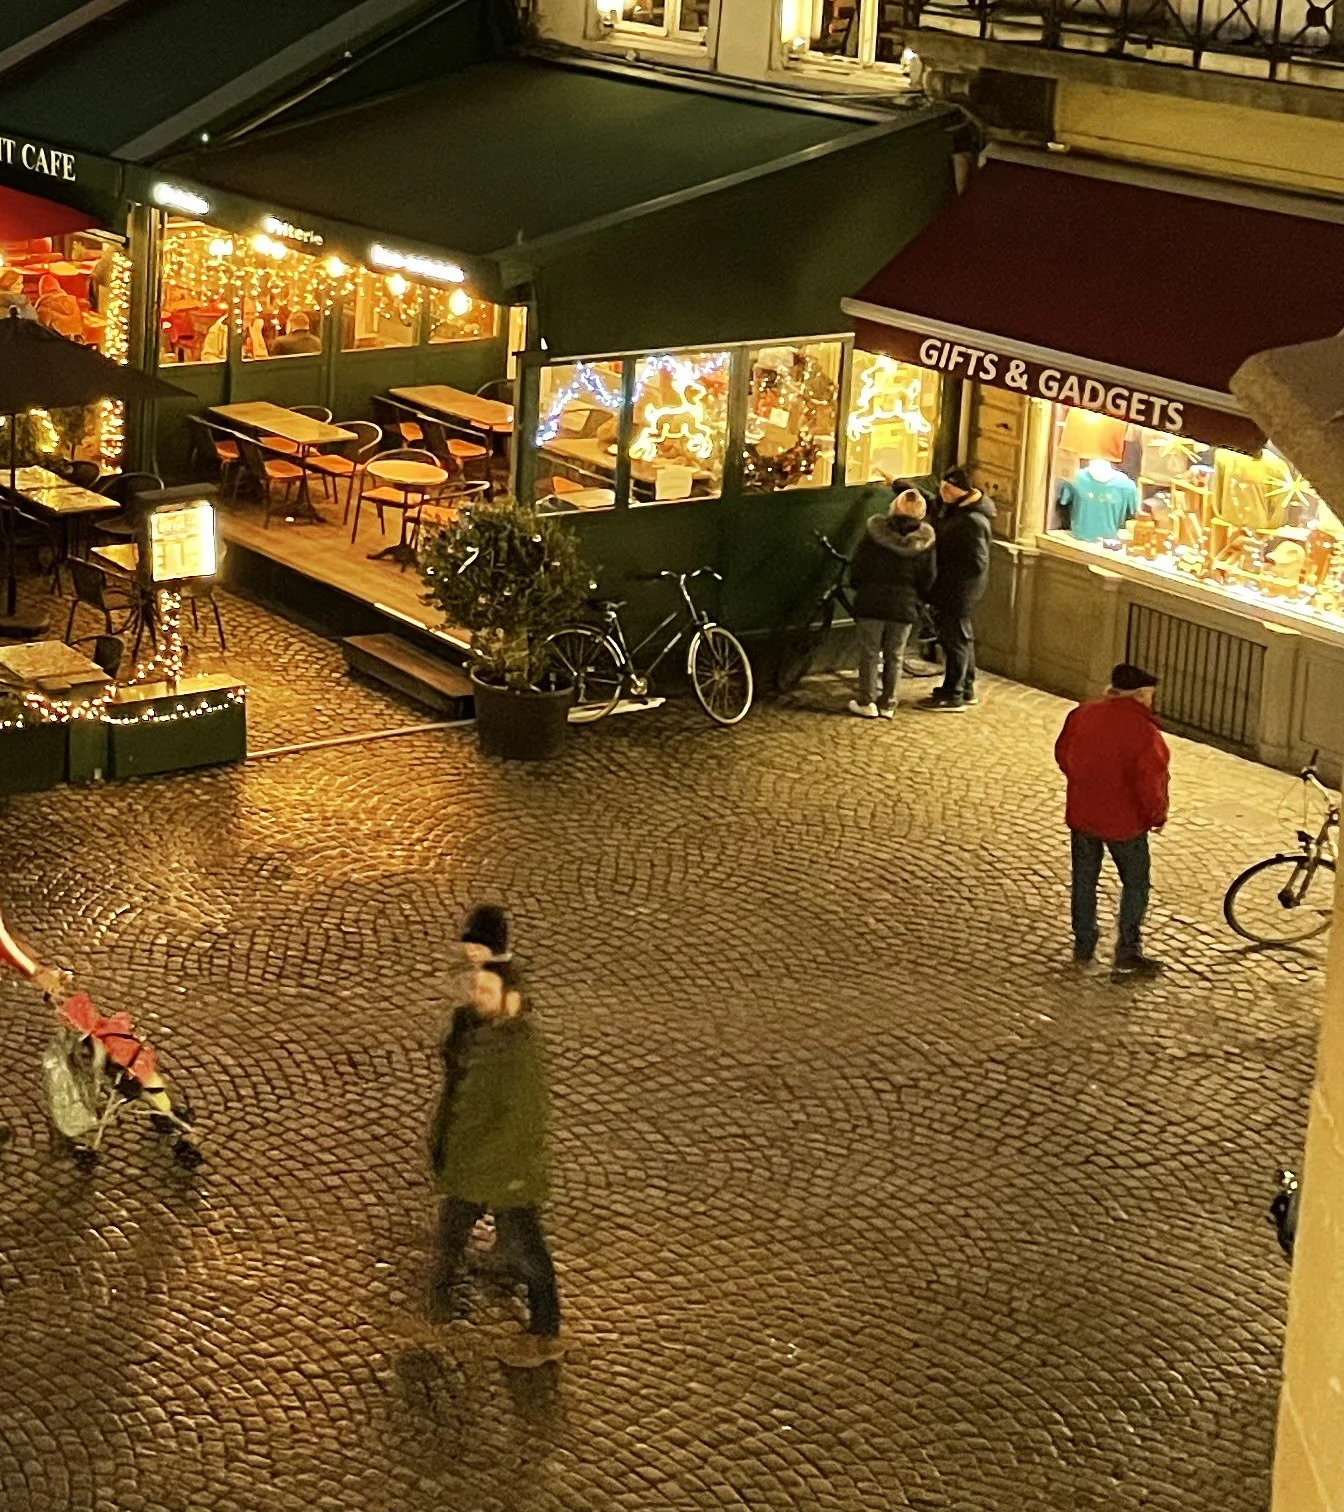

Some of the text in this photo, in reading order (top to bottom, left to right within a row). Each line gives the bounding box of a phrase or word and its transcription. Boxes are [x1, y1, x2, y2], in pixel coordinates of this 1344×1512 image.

[21, 143, 76, 181] CAFE
[919, 338, 1185, 432] GIFTS & GADGETS
